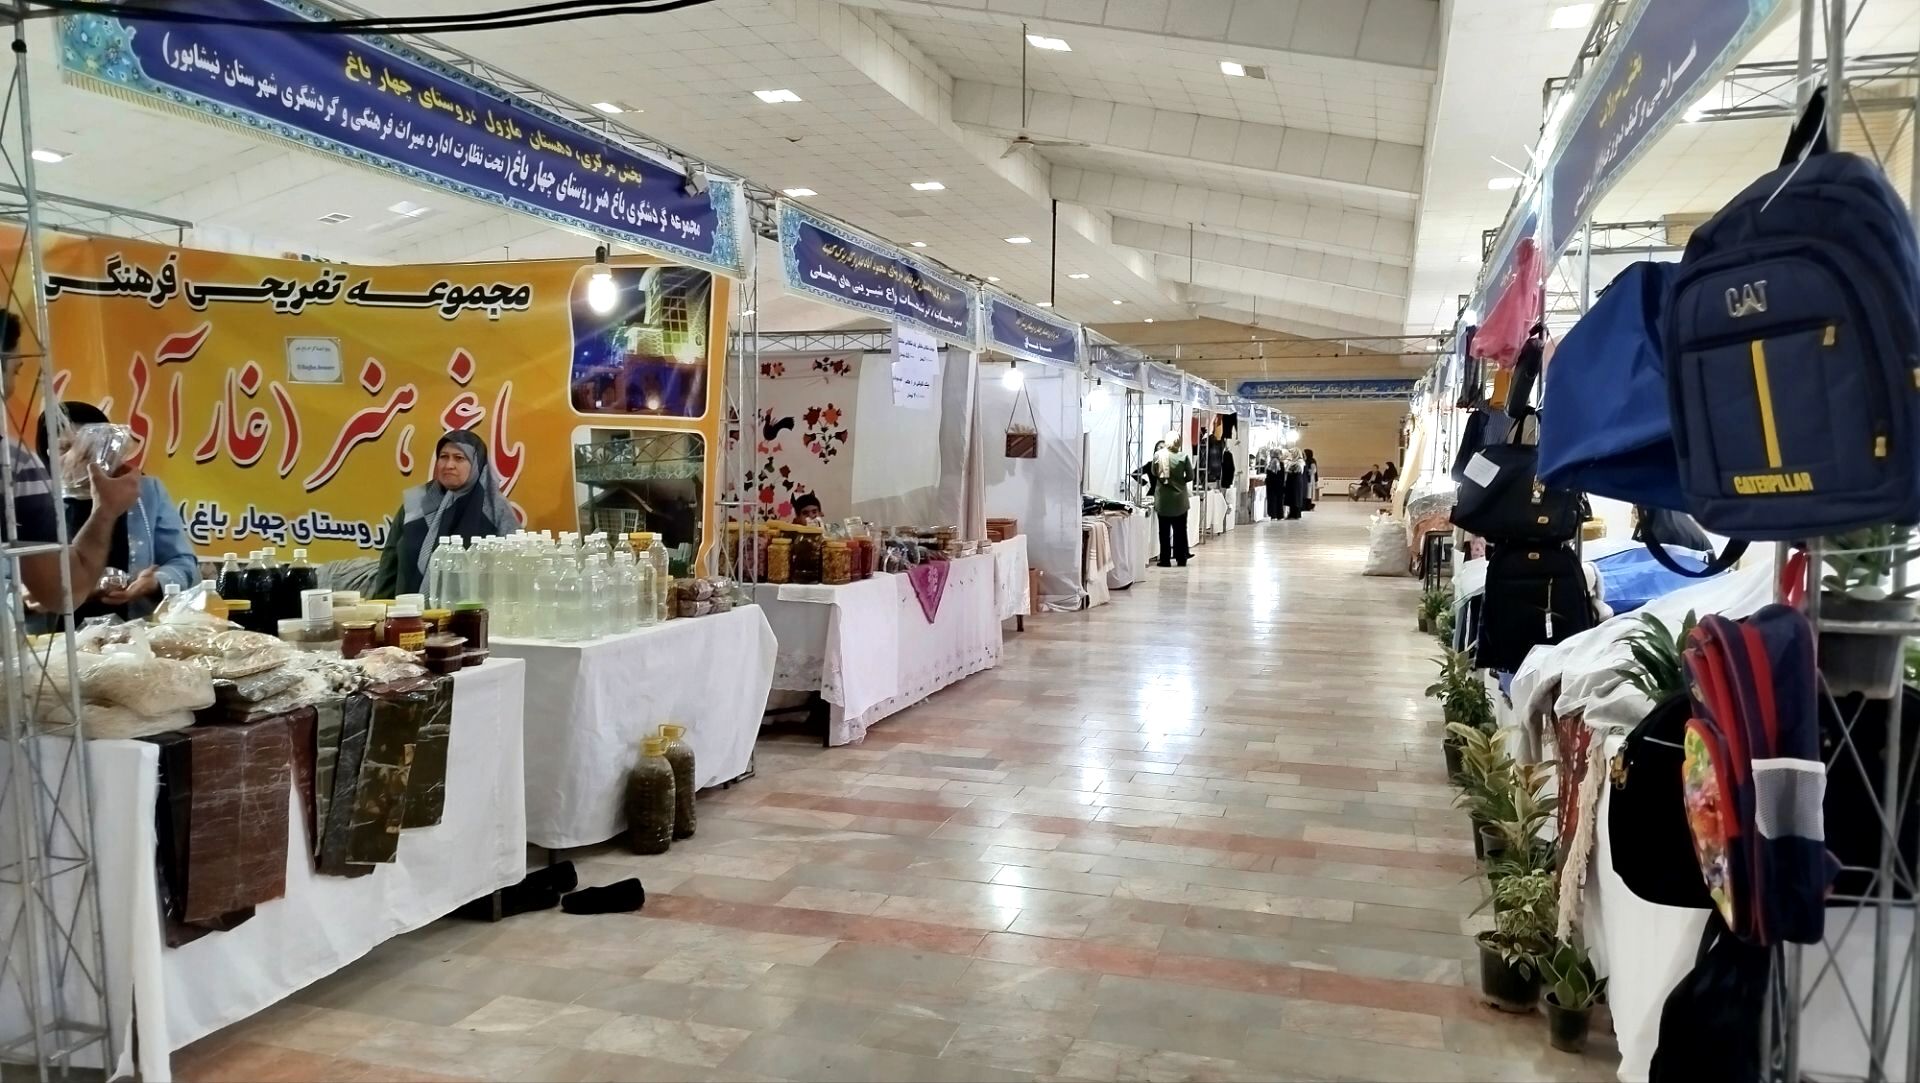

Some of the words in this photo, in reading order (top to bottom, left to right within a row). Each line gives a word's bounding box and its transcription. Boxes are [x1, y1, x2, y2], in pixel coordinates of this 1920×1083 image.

[223, 57, 279, 98] شهرستان
[344, 50, 372, 85] باغ
[280, 83, 340, 122] گردشگری
[378, 68, 413, 103] چهار
[340, 106, 349, 128] و
[350, 105, 394, 141] فرهنگی
[484, 109, 523, 139] مازول
[394, 119, 425, 150] میراث
[426, 132, 454, 158] اداره
[529, 129, 573, 158] دهستان
[453, 141, 484, 167] نظارت
[528, 160, 556, 198] چهار
[555, 171, 593, 211] روستای
[618, 163, 642, 188] بخش
[595, 191, 609, 214] هنر
[610, 186, 625, 220] باغ
[626, 200, 668, 233] گردشگری
[670, 212, 701, 240] مجموعه
[44, 252, 179, 303] فرهنگی
[809, 263, 838, 280] محلی
[838, 273, 851, 289] های
[184, 269, 347, 311] تفریحی
[345, 278, 531, 317] مجموعه
[1725, 280, 1768, 319] CAT
[303, 358, 418, 489] هنر
[430, 349, 526, 525] باغ
[1733, 471, 1815, 495] CATERPILLAR
[234, 504, 288, 543] چهار
